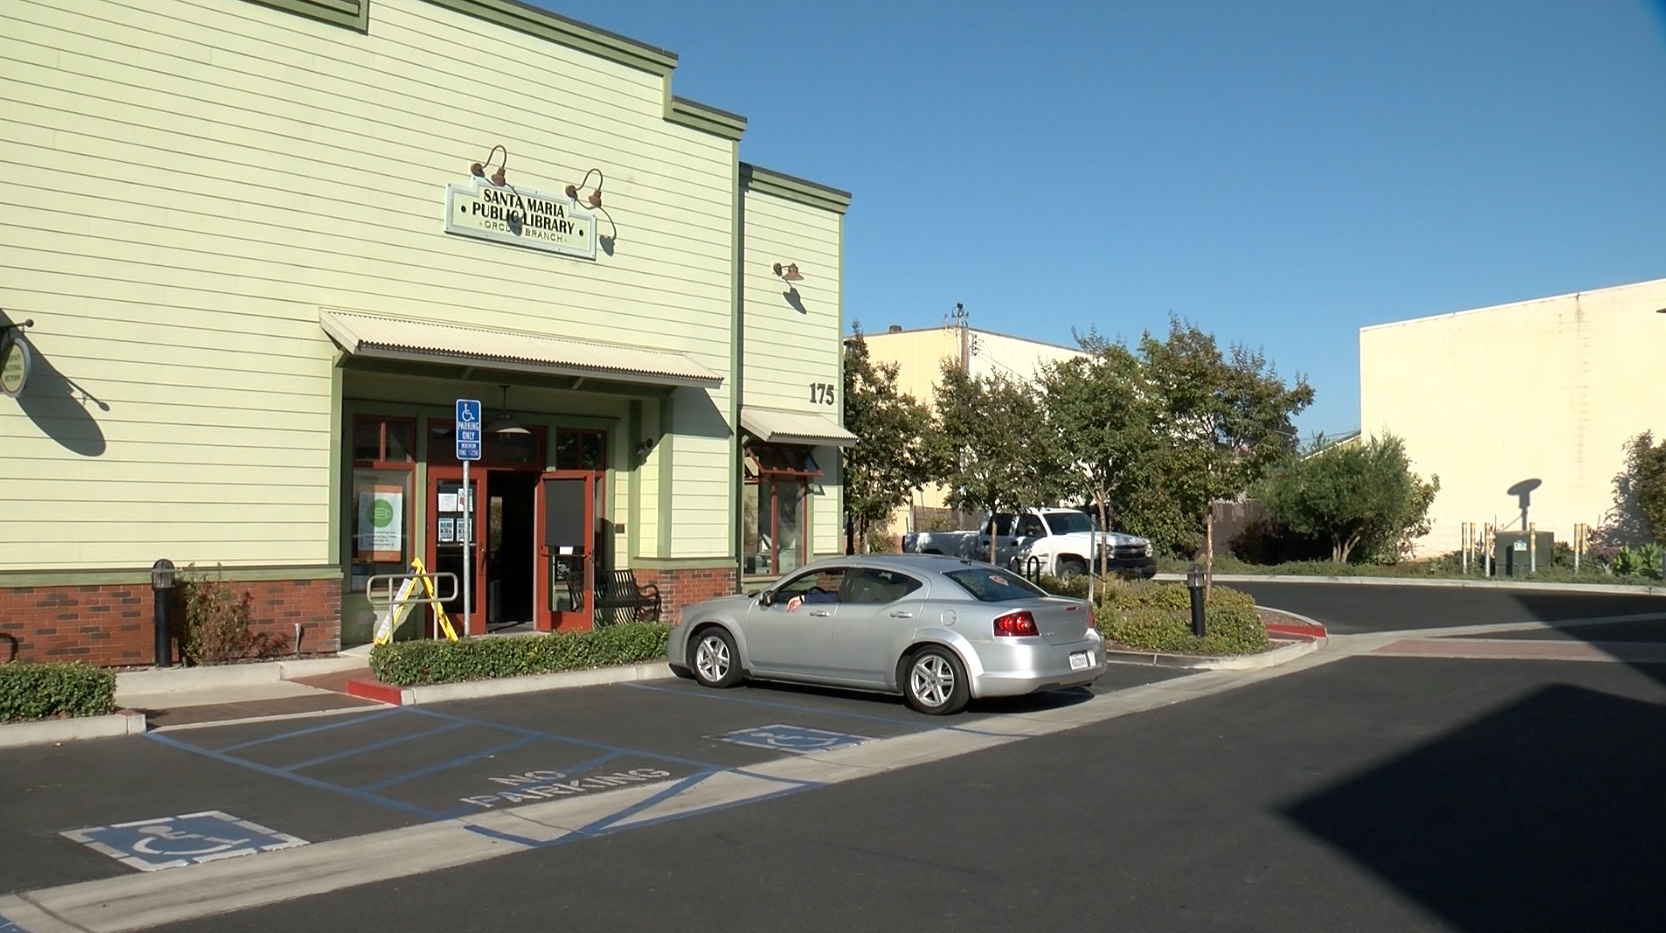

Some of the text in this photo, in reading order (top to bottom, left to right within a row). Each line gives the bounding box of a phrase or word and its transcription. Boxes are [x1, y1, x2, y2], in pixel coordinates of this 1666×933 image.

[484, 189, 565, 218] SANTA MARIA
[472, 202, 575, 235] PUBLIC LIBRARY
[484, 220, 563, 242] ORCUTT BRANCH
[809, 382, 834, 405] 175
[458, 421, 479, 431] PARKING
[462, 431, 475, 440] ONLY
[460, 769, 670, 807] PARKING
[488, 770, 566, 785] NO
